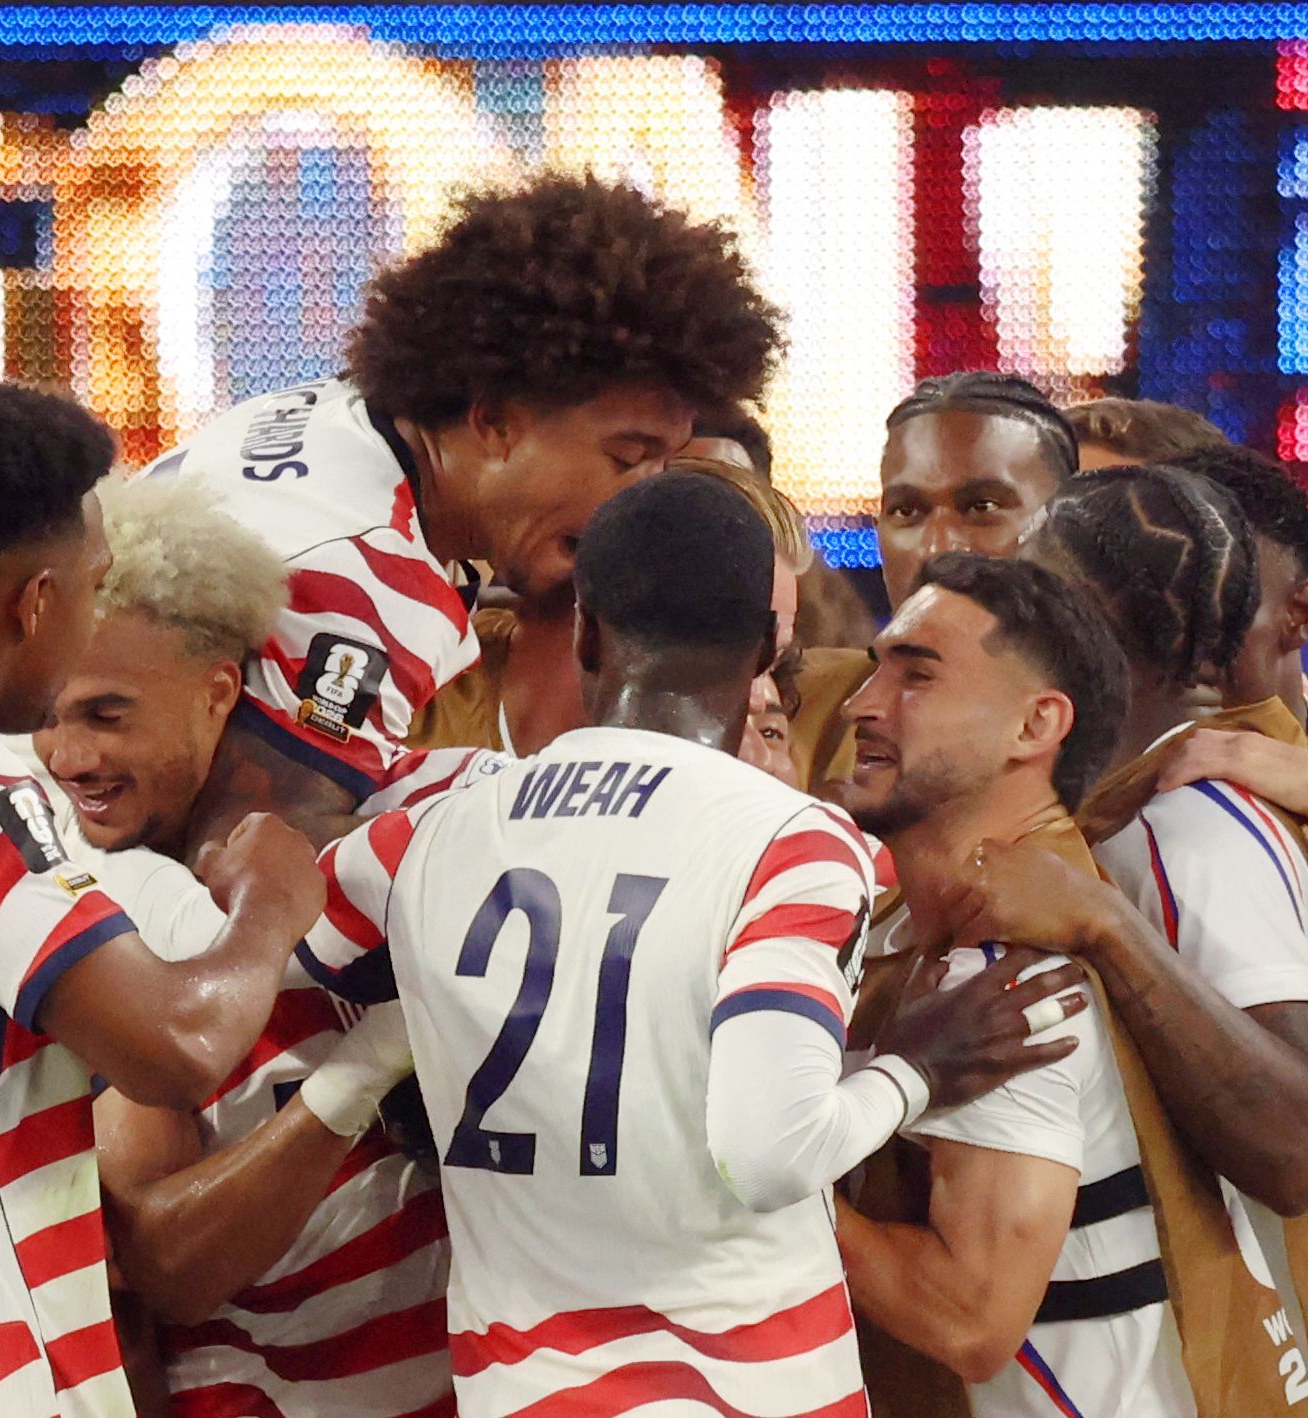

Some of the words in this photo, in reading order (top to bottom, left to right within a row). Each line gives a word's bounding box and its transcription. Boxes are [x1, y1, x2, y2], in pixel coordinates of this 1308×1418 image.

[240, 378, 326, 482] CHARDS
[508, 761, 673, 821] WEAH
[443, 867, 670, 1176] 21
